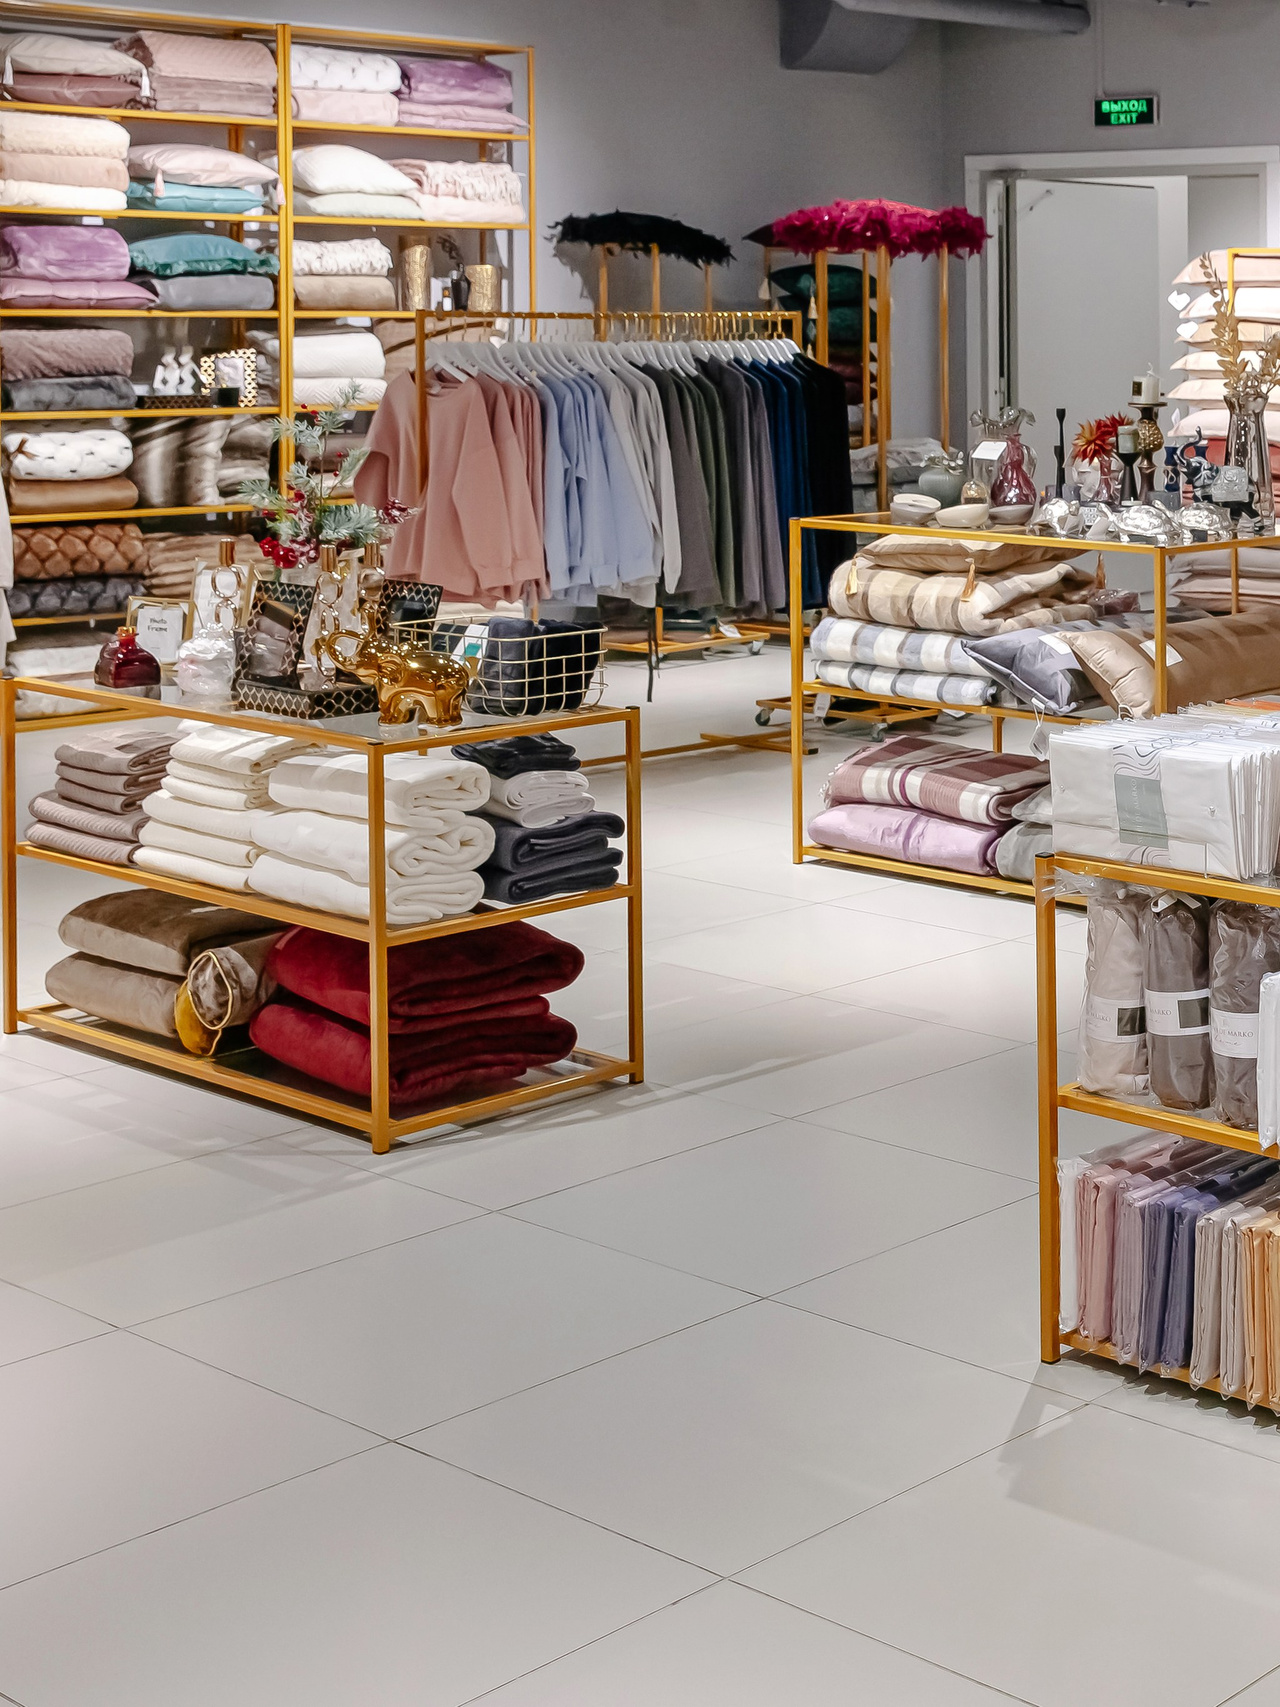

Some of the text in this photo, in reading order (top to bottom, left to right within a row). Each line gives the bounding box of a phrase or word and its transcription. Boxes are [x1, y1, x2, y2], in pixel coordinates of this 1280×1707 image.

[1101, 99, 1147, 113] ВЫХОД
[1110, 112, 1138, 125] EXIT
[1227, 1030, 1254, 1038] MARKO
